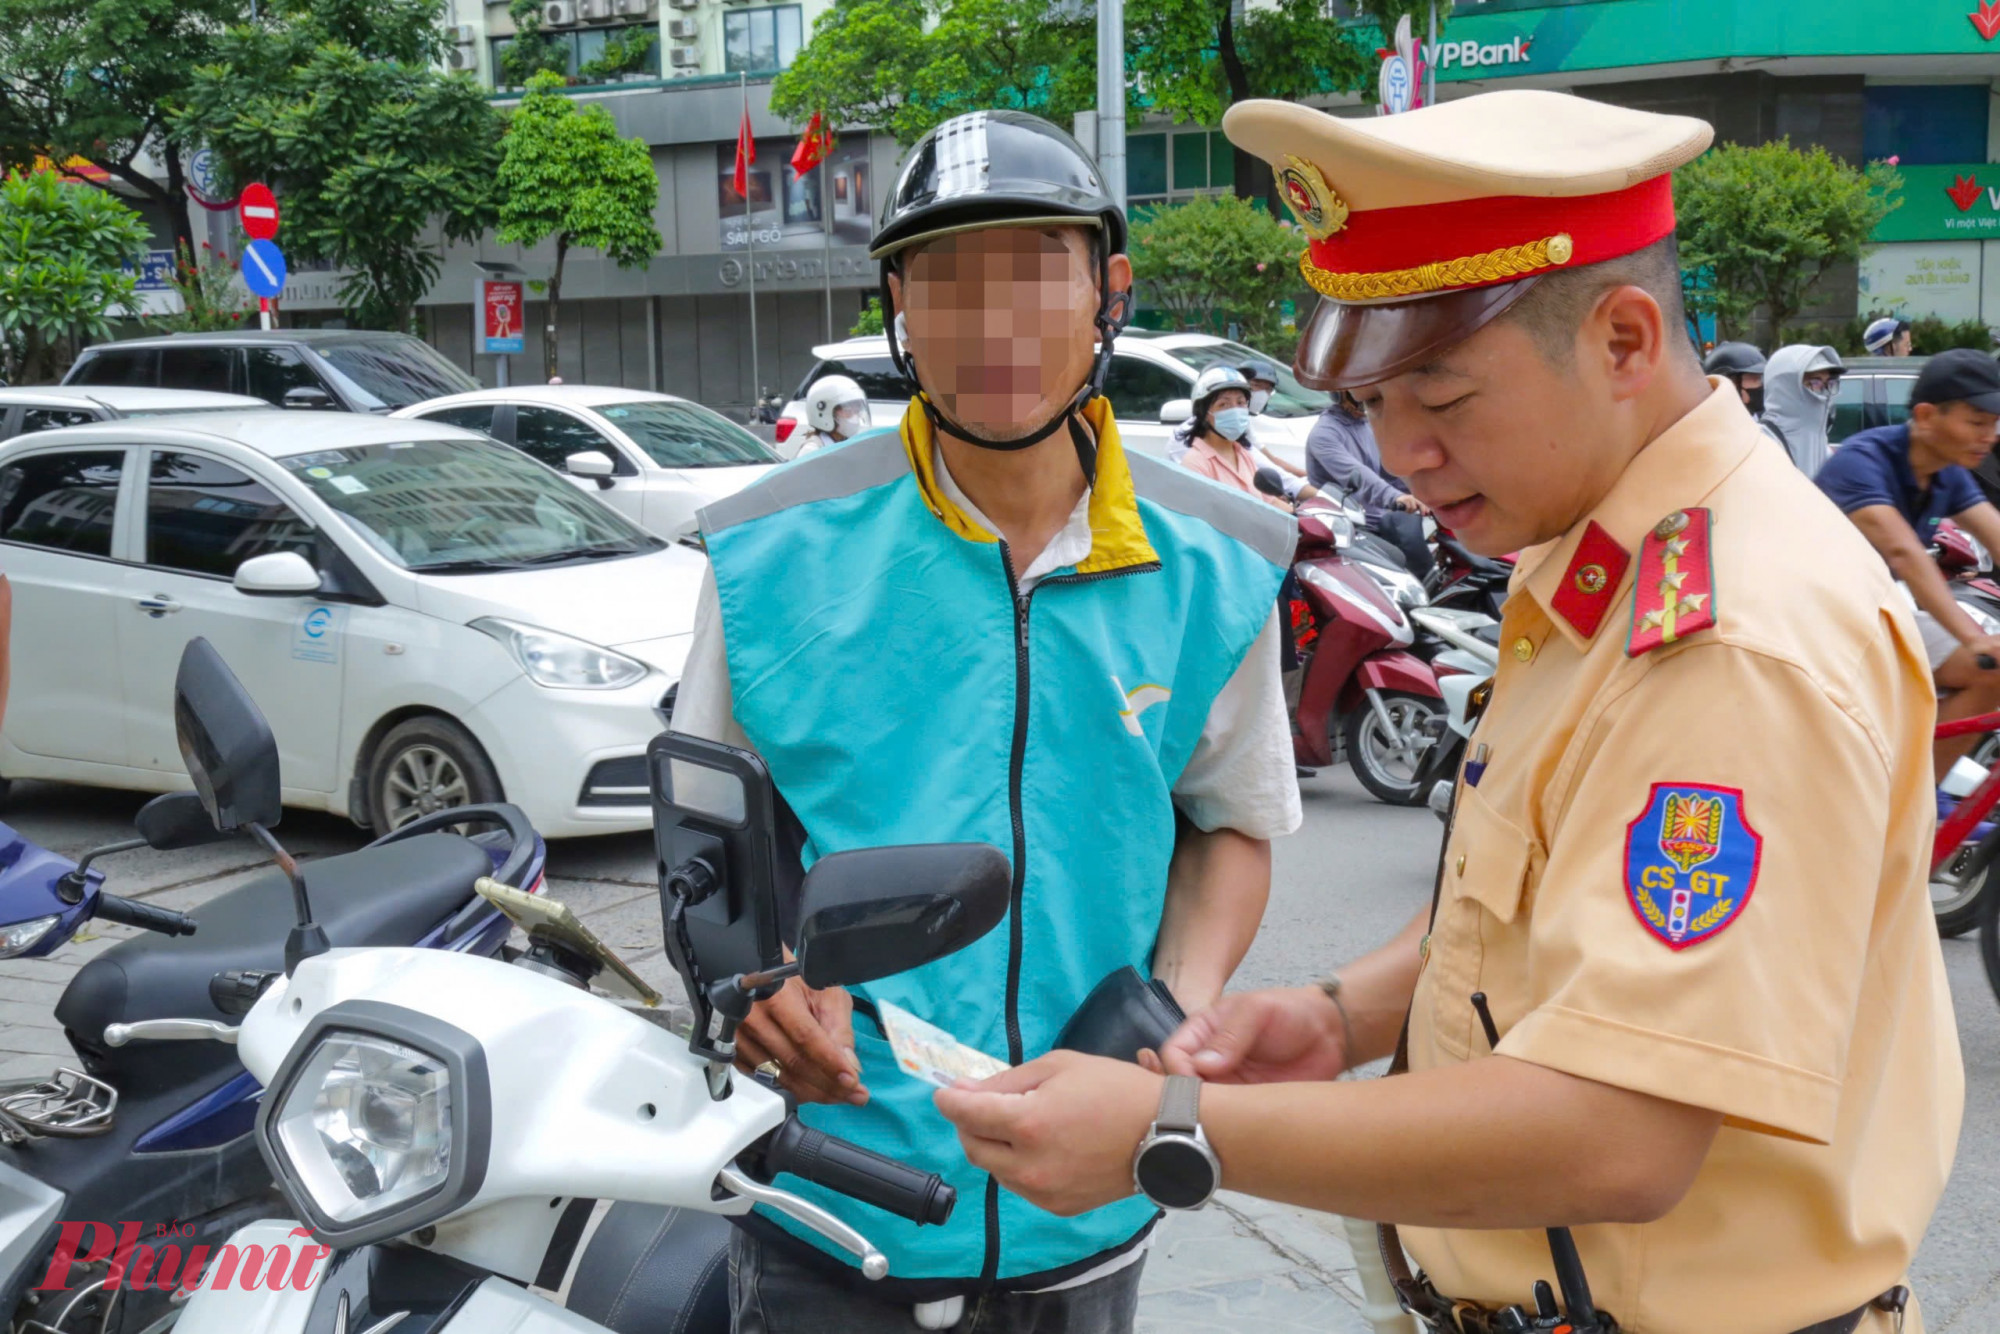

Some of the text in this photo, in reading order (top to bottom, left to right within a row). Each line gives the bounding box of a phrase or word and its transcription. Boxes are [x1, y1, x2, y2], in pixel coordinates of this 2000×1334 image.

[1421, 35, 1531, 69] VPBank
[759, 222, 782, 243] GỖ
[745, 252, 873, 280] artemnd
[1641, 865, 1731, 898] CS GT
